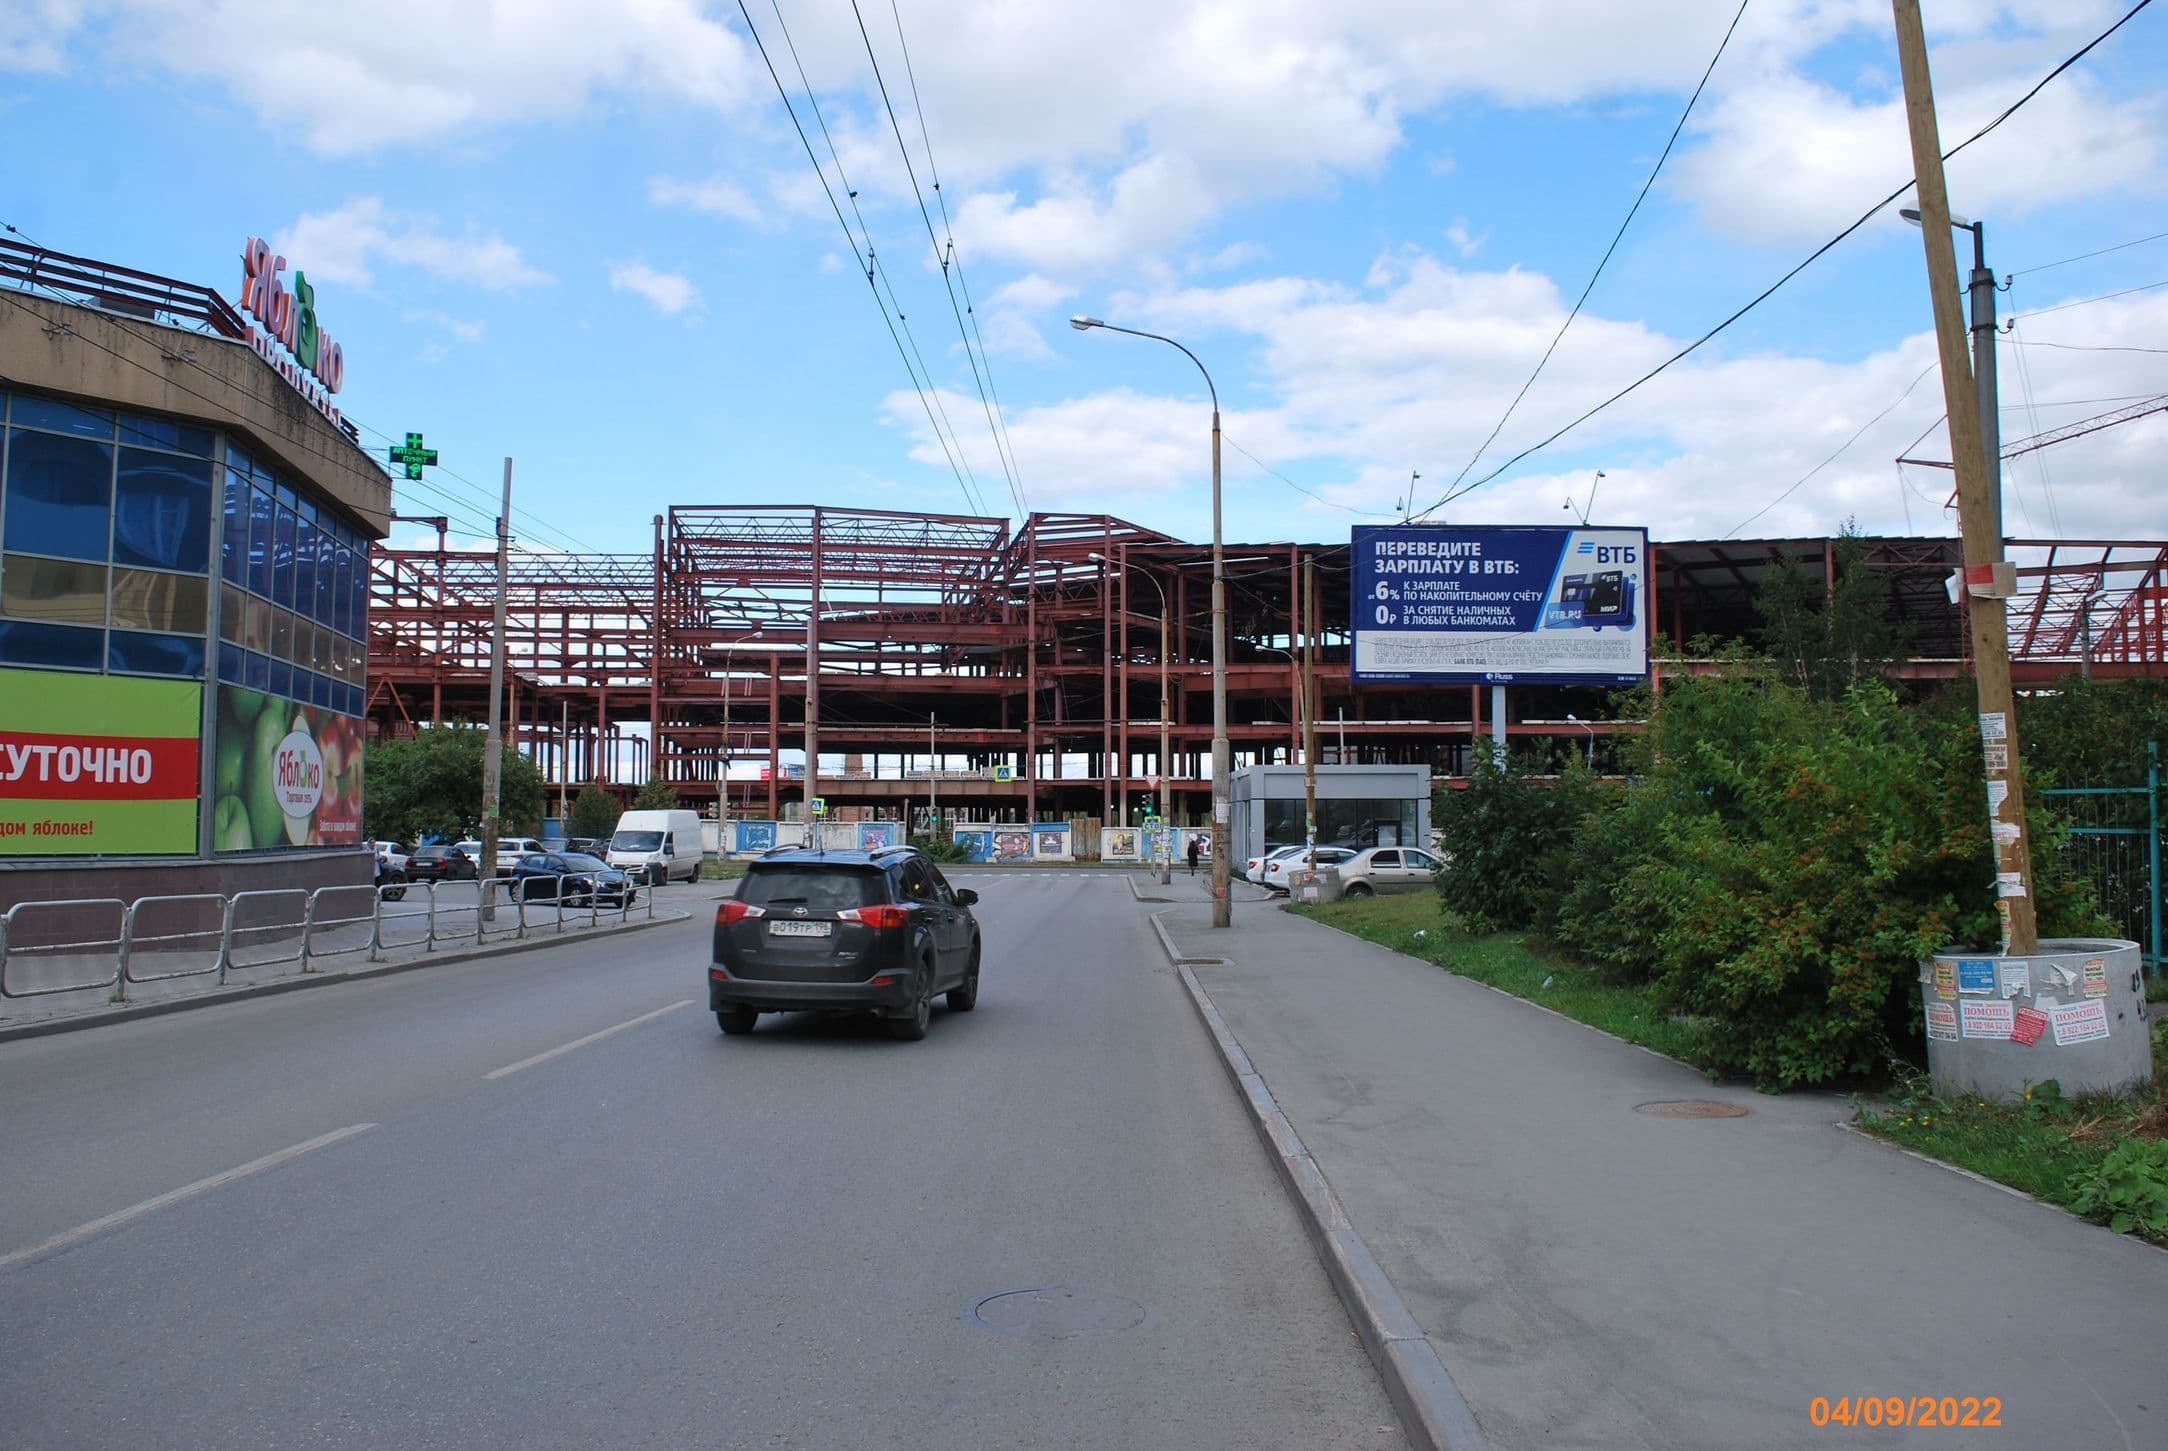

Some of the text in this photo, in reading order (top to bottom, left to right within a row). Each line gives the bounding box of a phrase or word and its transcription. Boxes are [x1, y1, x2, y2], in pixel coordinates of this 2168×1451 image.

[242, 236, 343, 394] Яблоко
[1375, 541, 1482, 558] ПЕРЕВЕДИТЕ
[1597, 546, 1636, 564] ВТБ
[1375, 559, 1519, 574] ЗАРПЛАТУ В ВТБ:
[1403, 581, 1460, 591] К ЗАРПЛАТЕ
[1403, 589, 1543, 602] ПО НАКОПИТЕЛЬНОМУ СЧЁТУ
[1403, 605, 1511, 616] ЗА СНЯТИЕ НАЛИЧНЫХ
[1403, 616, 1516, 626] В ЛЮБЫХ БАНКОМАТАХ
[0, 744, 152, 784] УТОЧНО
[278, 750, 320, 789] Яблоко
[32, 820, 93, 836] яблоке!
